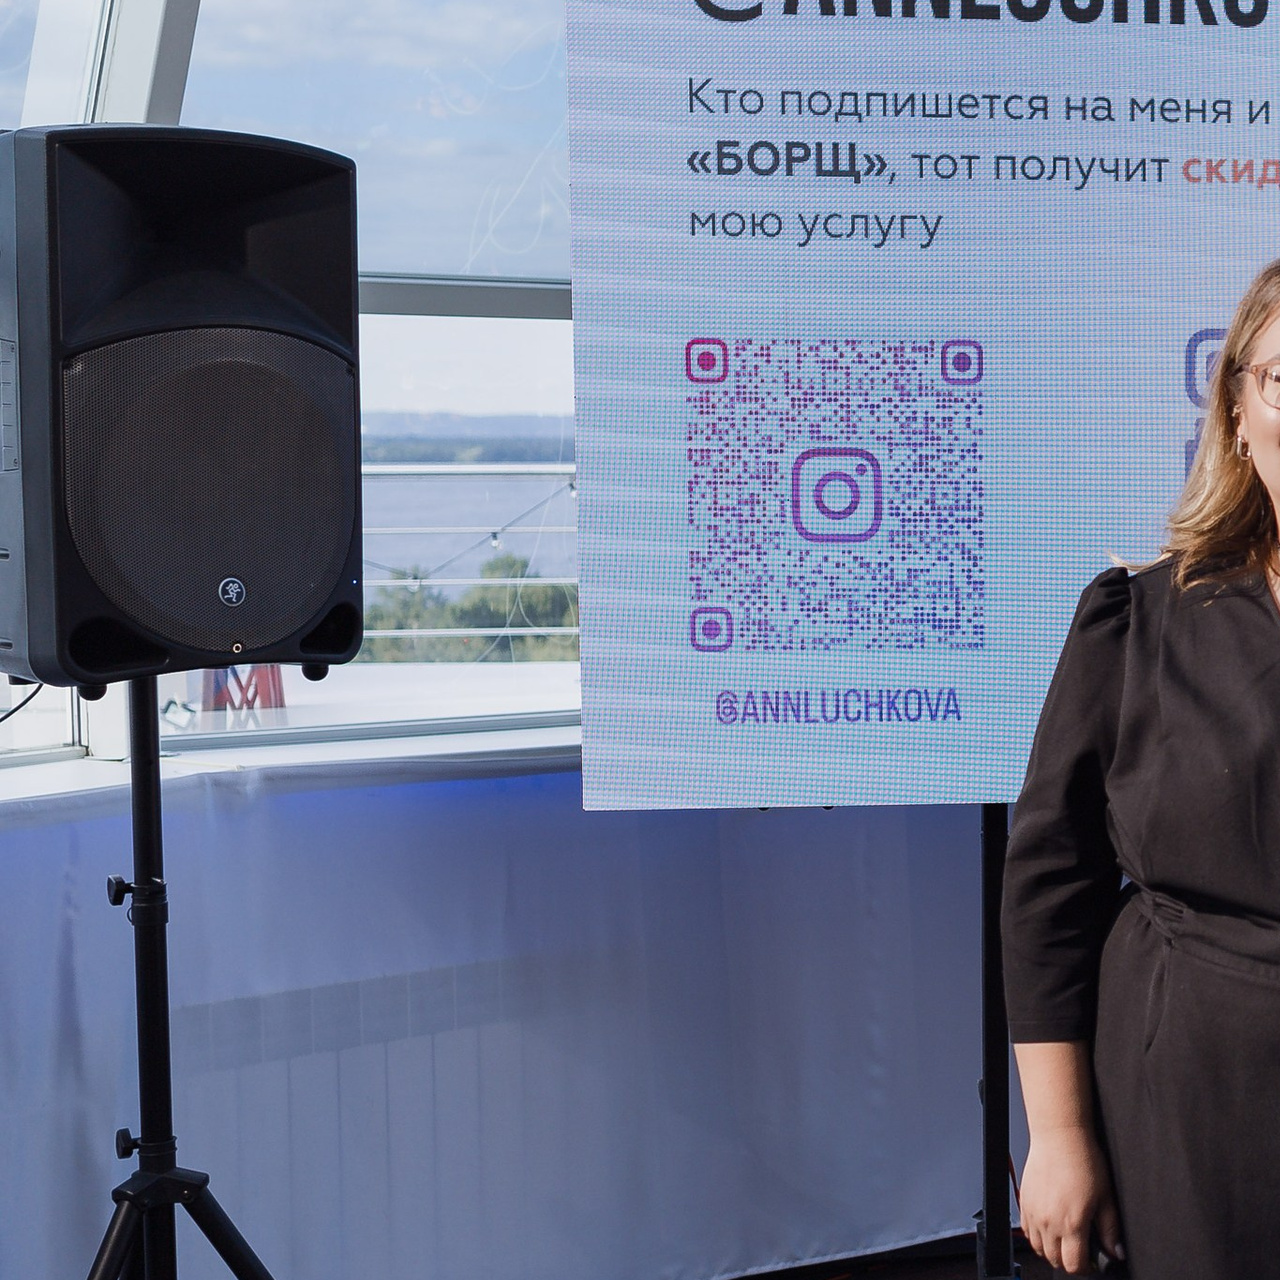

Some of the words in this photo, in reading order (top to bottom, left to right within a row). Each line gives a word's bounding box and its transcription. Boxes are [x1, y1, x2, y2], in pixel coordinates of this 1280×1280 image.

[687, 79, 765, 119] Кто
[779, 85, 1050, 124] подпишется
[1065, 92, 1115, 123] на
[1129, 94, 1234, 126] меня
[1248, 96, 1272, 127] и
[687, 141, 899, 185] «БОРЩ»,
[910, 150, 981, 183] тот
[994, 151, 1170, 194] получит
[689, 207, 784, 240] мою
[798, 210, 943, 249] услугу
[715, 689, 962, 726] @ANNLUCHKOVA
